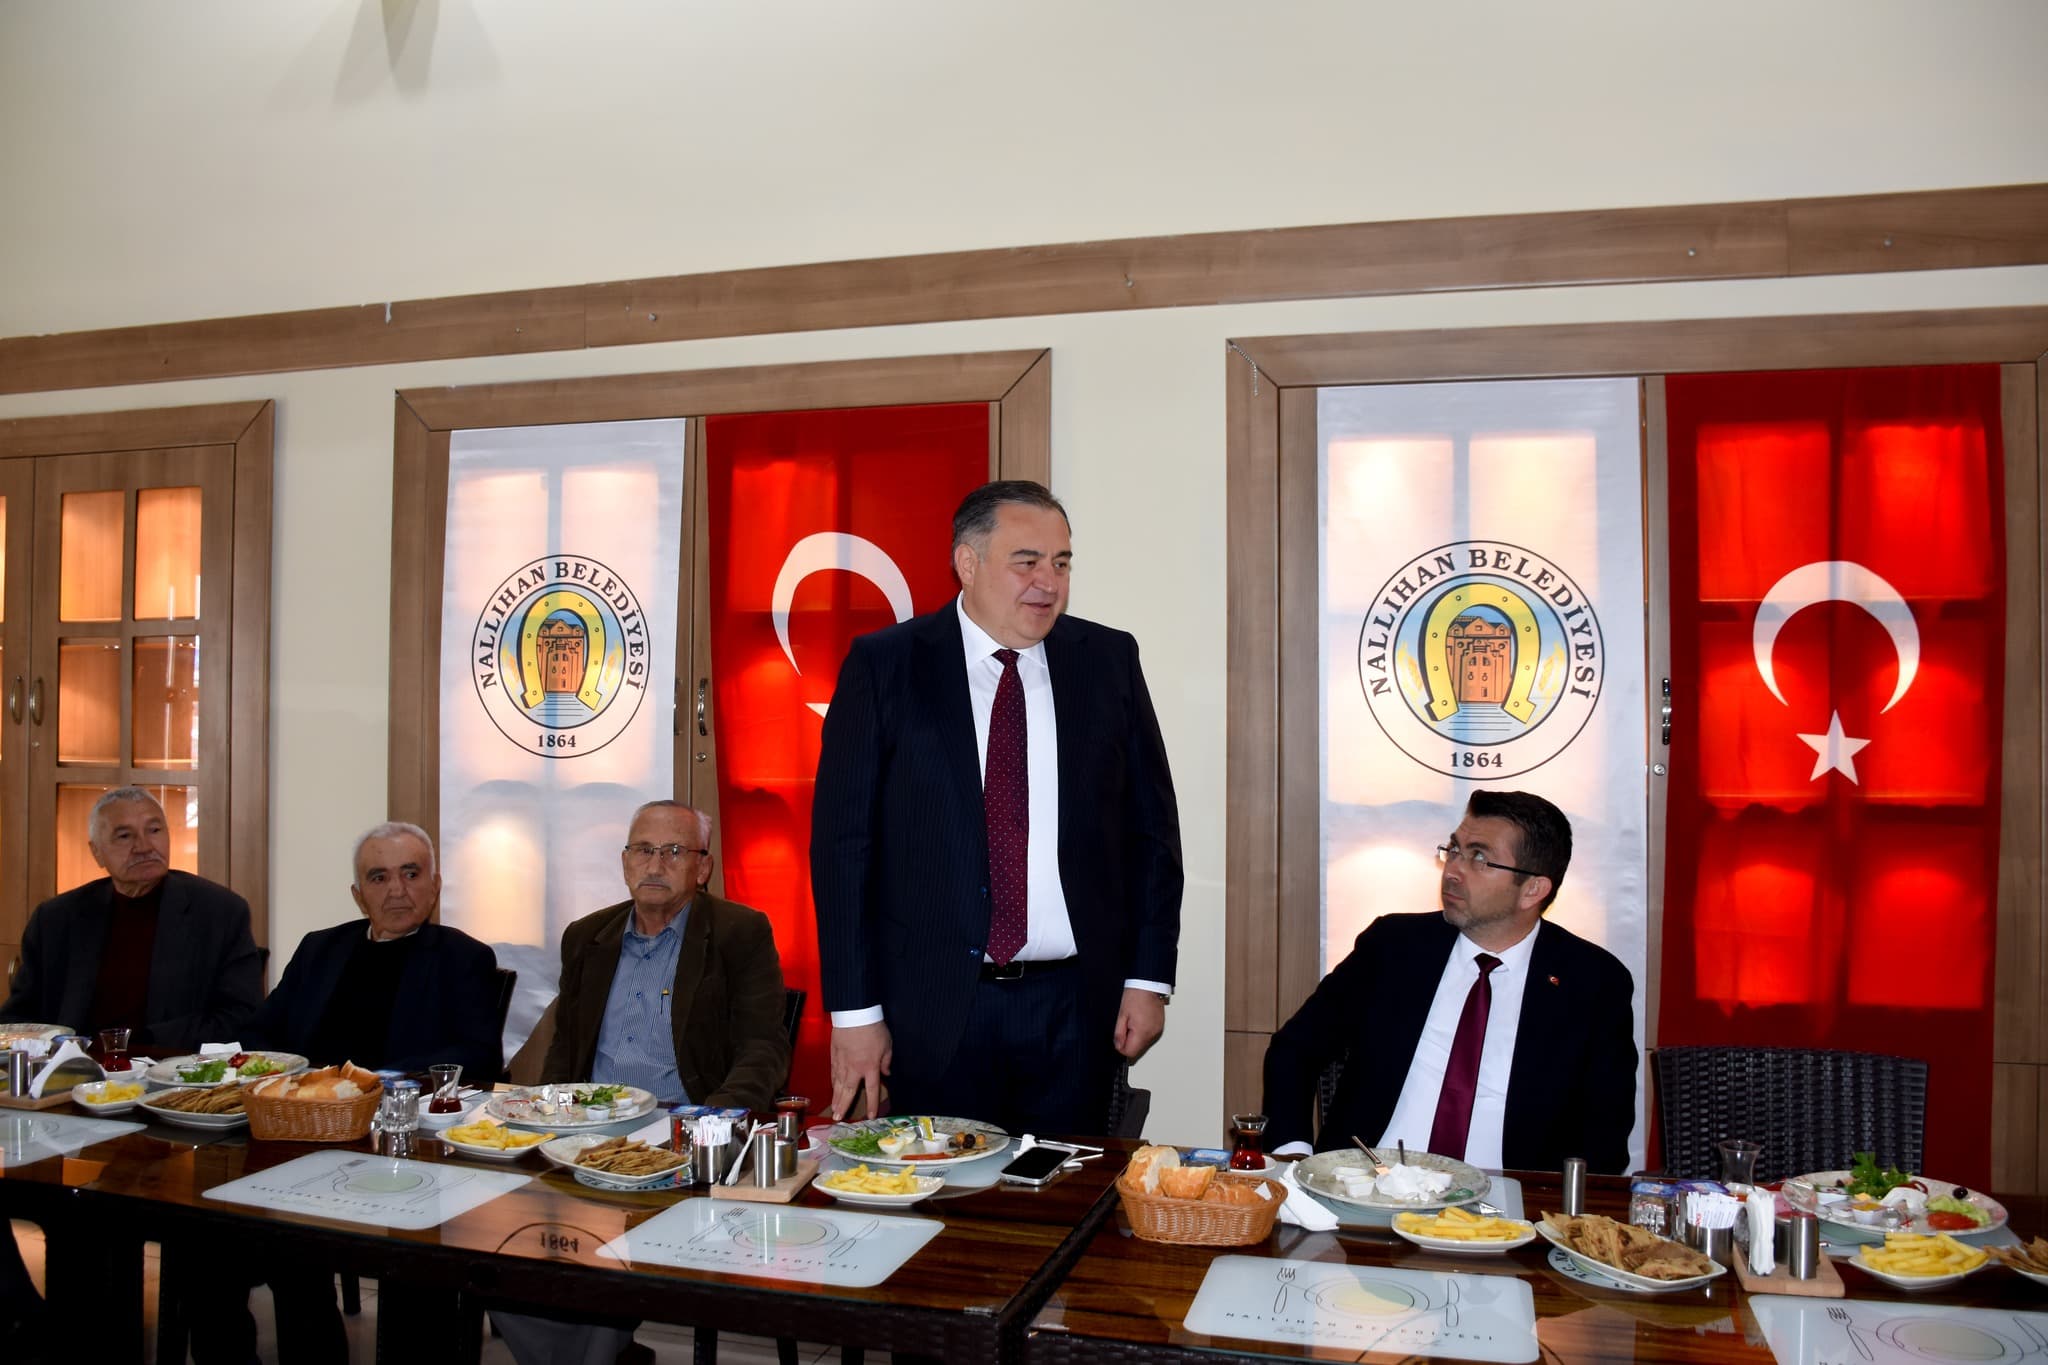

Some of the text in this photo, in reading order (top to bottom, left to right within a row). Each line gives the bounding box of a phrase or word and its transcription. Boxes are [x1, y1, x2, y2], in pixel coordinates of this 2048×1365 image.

[478, 561, 644, 690] NALLIHAN BELEDİYESİ
[1367, 549, 1596, 700] NALLIHAN BELEDİYESİ
[538, 734, 576, 748] 1864
[1450, 752, 1503, 768] 1864
